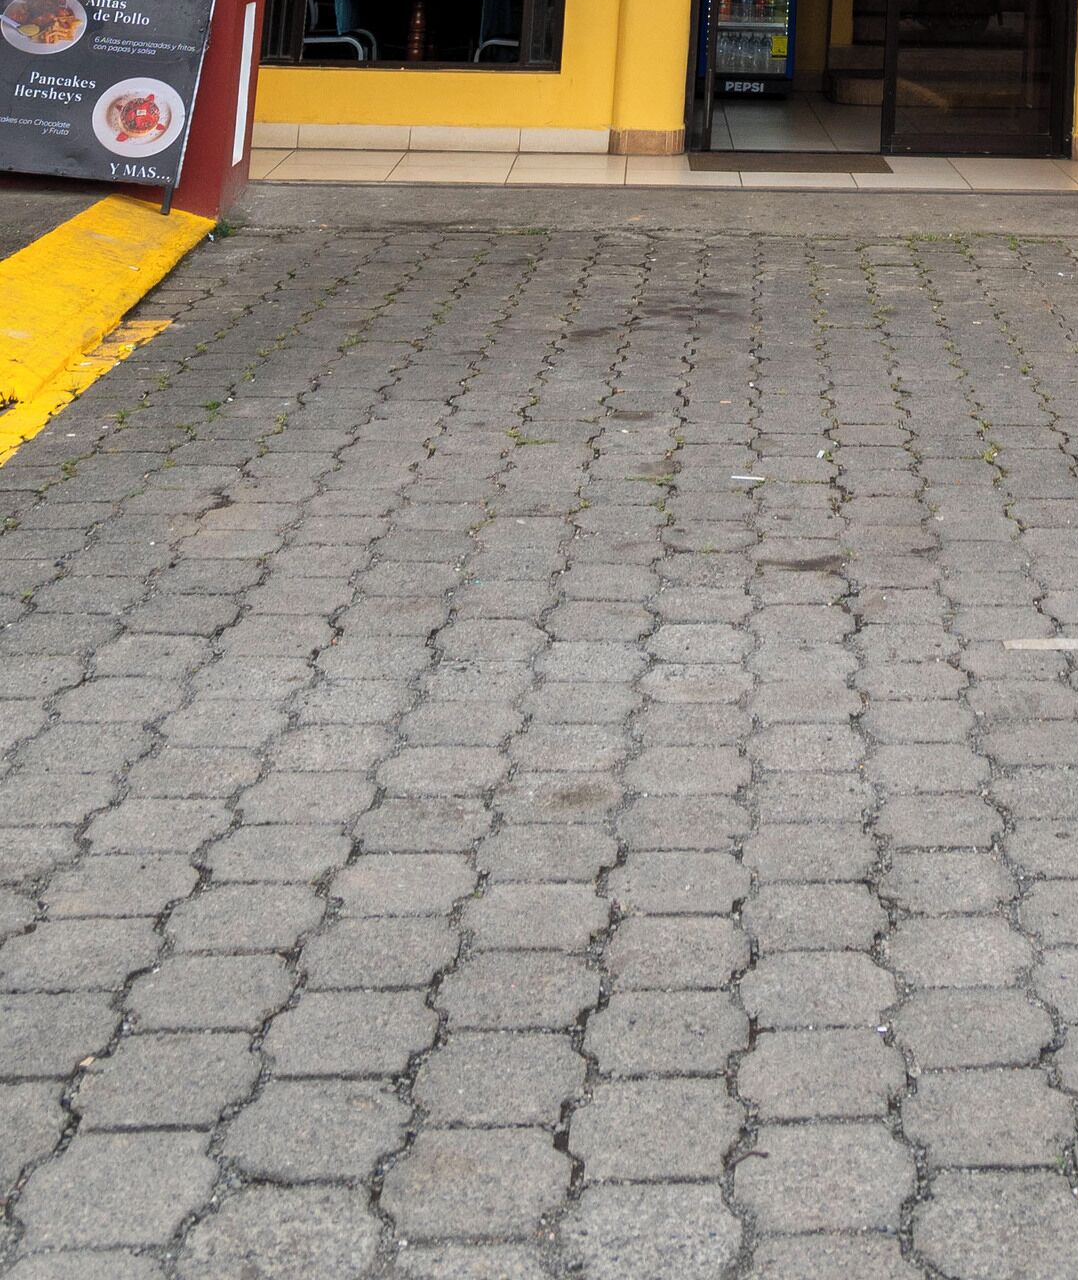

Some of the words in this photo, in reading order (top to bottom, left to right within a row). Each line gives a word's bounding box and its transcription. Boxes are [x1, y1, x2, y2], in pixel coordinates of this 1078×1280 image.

[93, 9, 111, 22] de
[114, 11, 150, 26] Pollo
[100, 37, 121, 45] Alitas
[121, 39, 171, 50] empanizadas
[177, 43, 196, 52] fritas
[107, 44, 131, 53] papas
[30, 71, 96, 89] Pancakes
[724, 81, 765, 93] PEPSI
[14, 84, 82, 104] Hersheys
[33, 118, 71, 128] Chocolate
[48, 127, 69, 135] Fruta
[109, 163, 120, 175] Y
